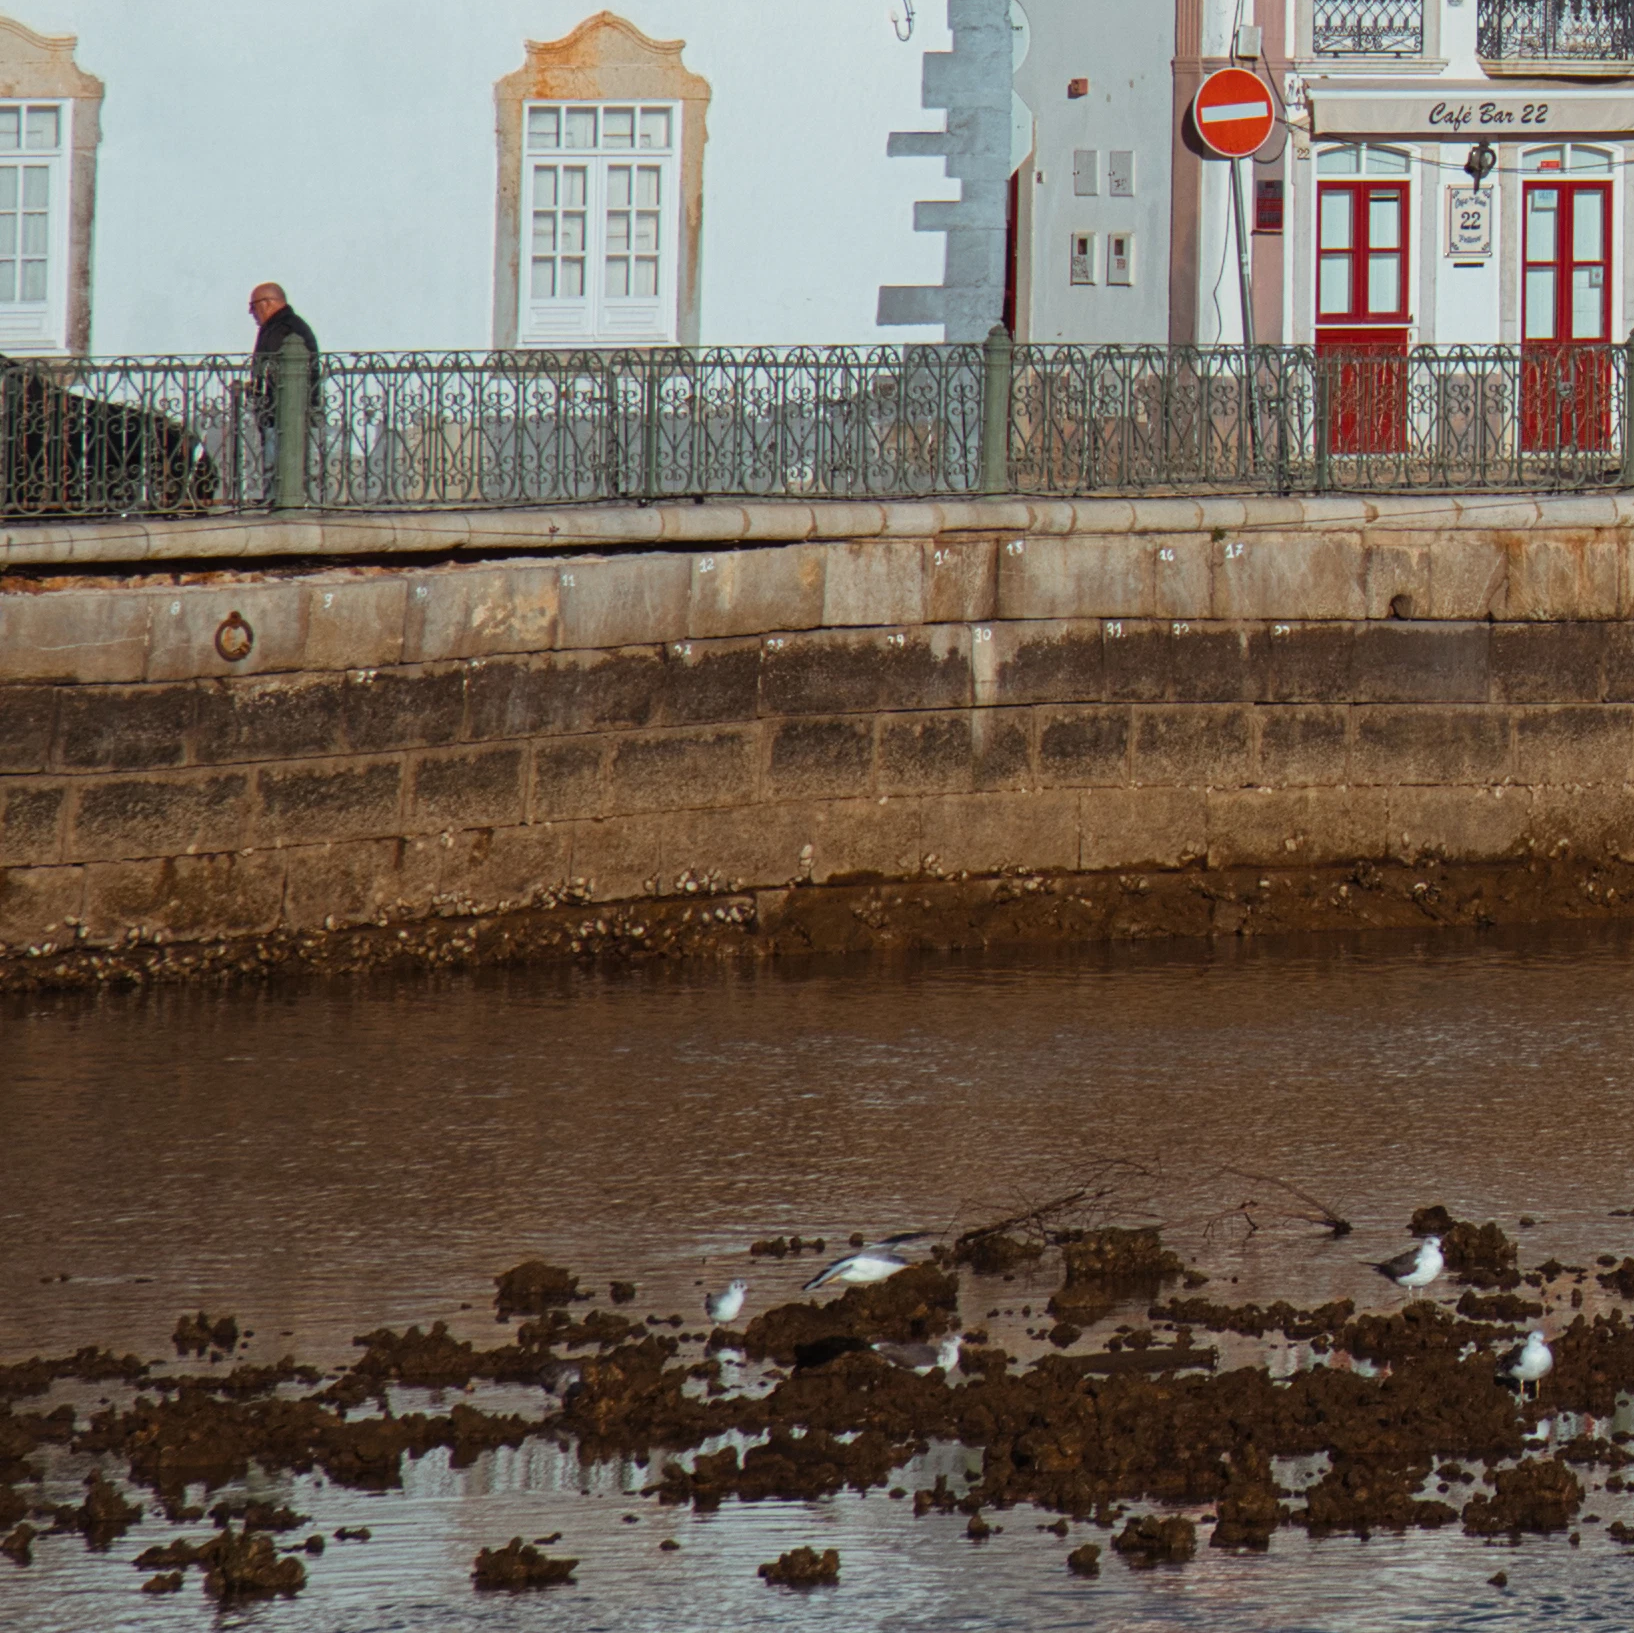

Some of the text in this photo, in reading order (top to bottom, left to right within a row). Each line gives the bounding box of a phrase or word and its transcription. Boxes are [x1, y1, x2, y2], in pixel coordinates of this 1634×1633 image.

[1428, 101, 1549, 132] Café Bar 22
[1296, 147, 1311, 161] 22
[1460, 211, 1481, 230] 22
[699, 558, 715, 573] 12
[561, 574, 576, 587] 11
[974, 627, 992, 643] 30
